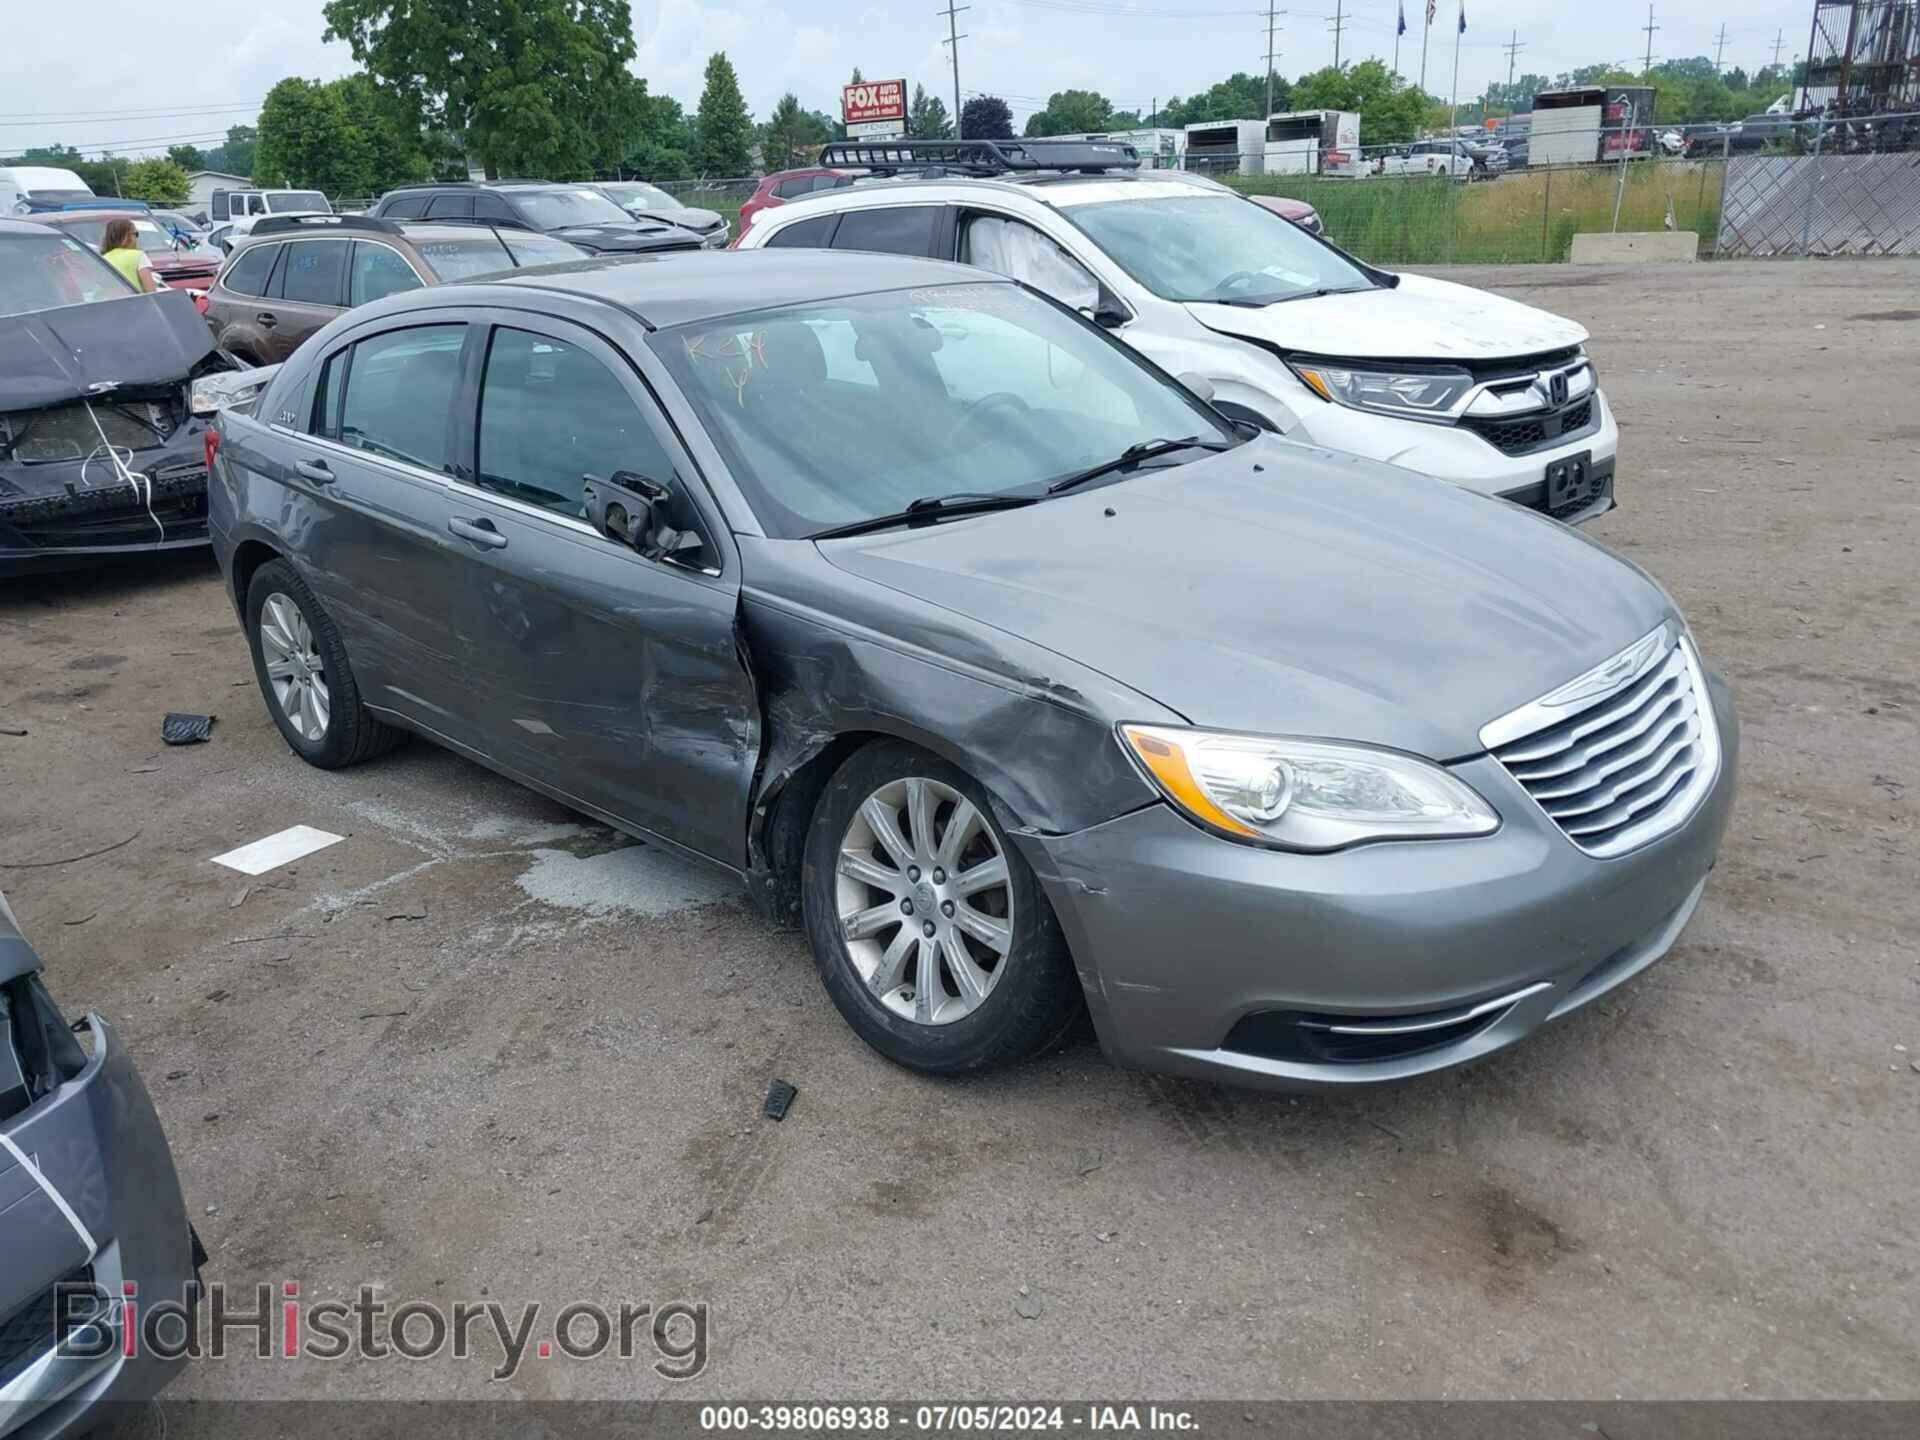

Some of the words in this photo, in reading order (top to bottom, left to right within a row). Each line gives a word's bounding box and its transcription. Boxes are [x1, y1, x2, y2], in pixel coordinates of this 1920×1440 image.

[880, 83, 898, 95] AUTO
[846, 86, 880, 109] FOX
[880, 94, 901, 105] PARTS
